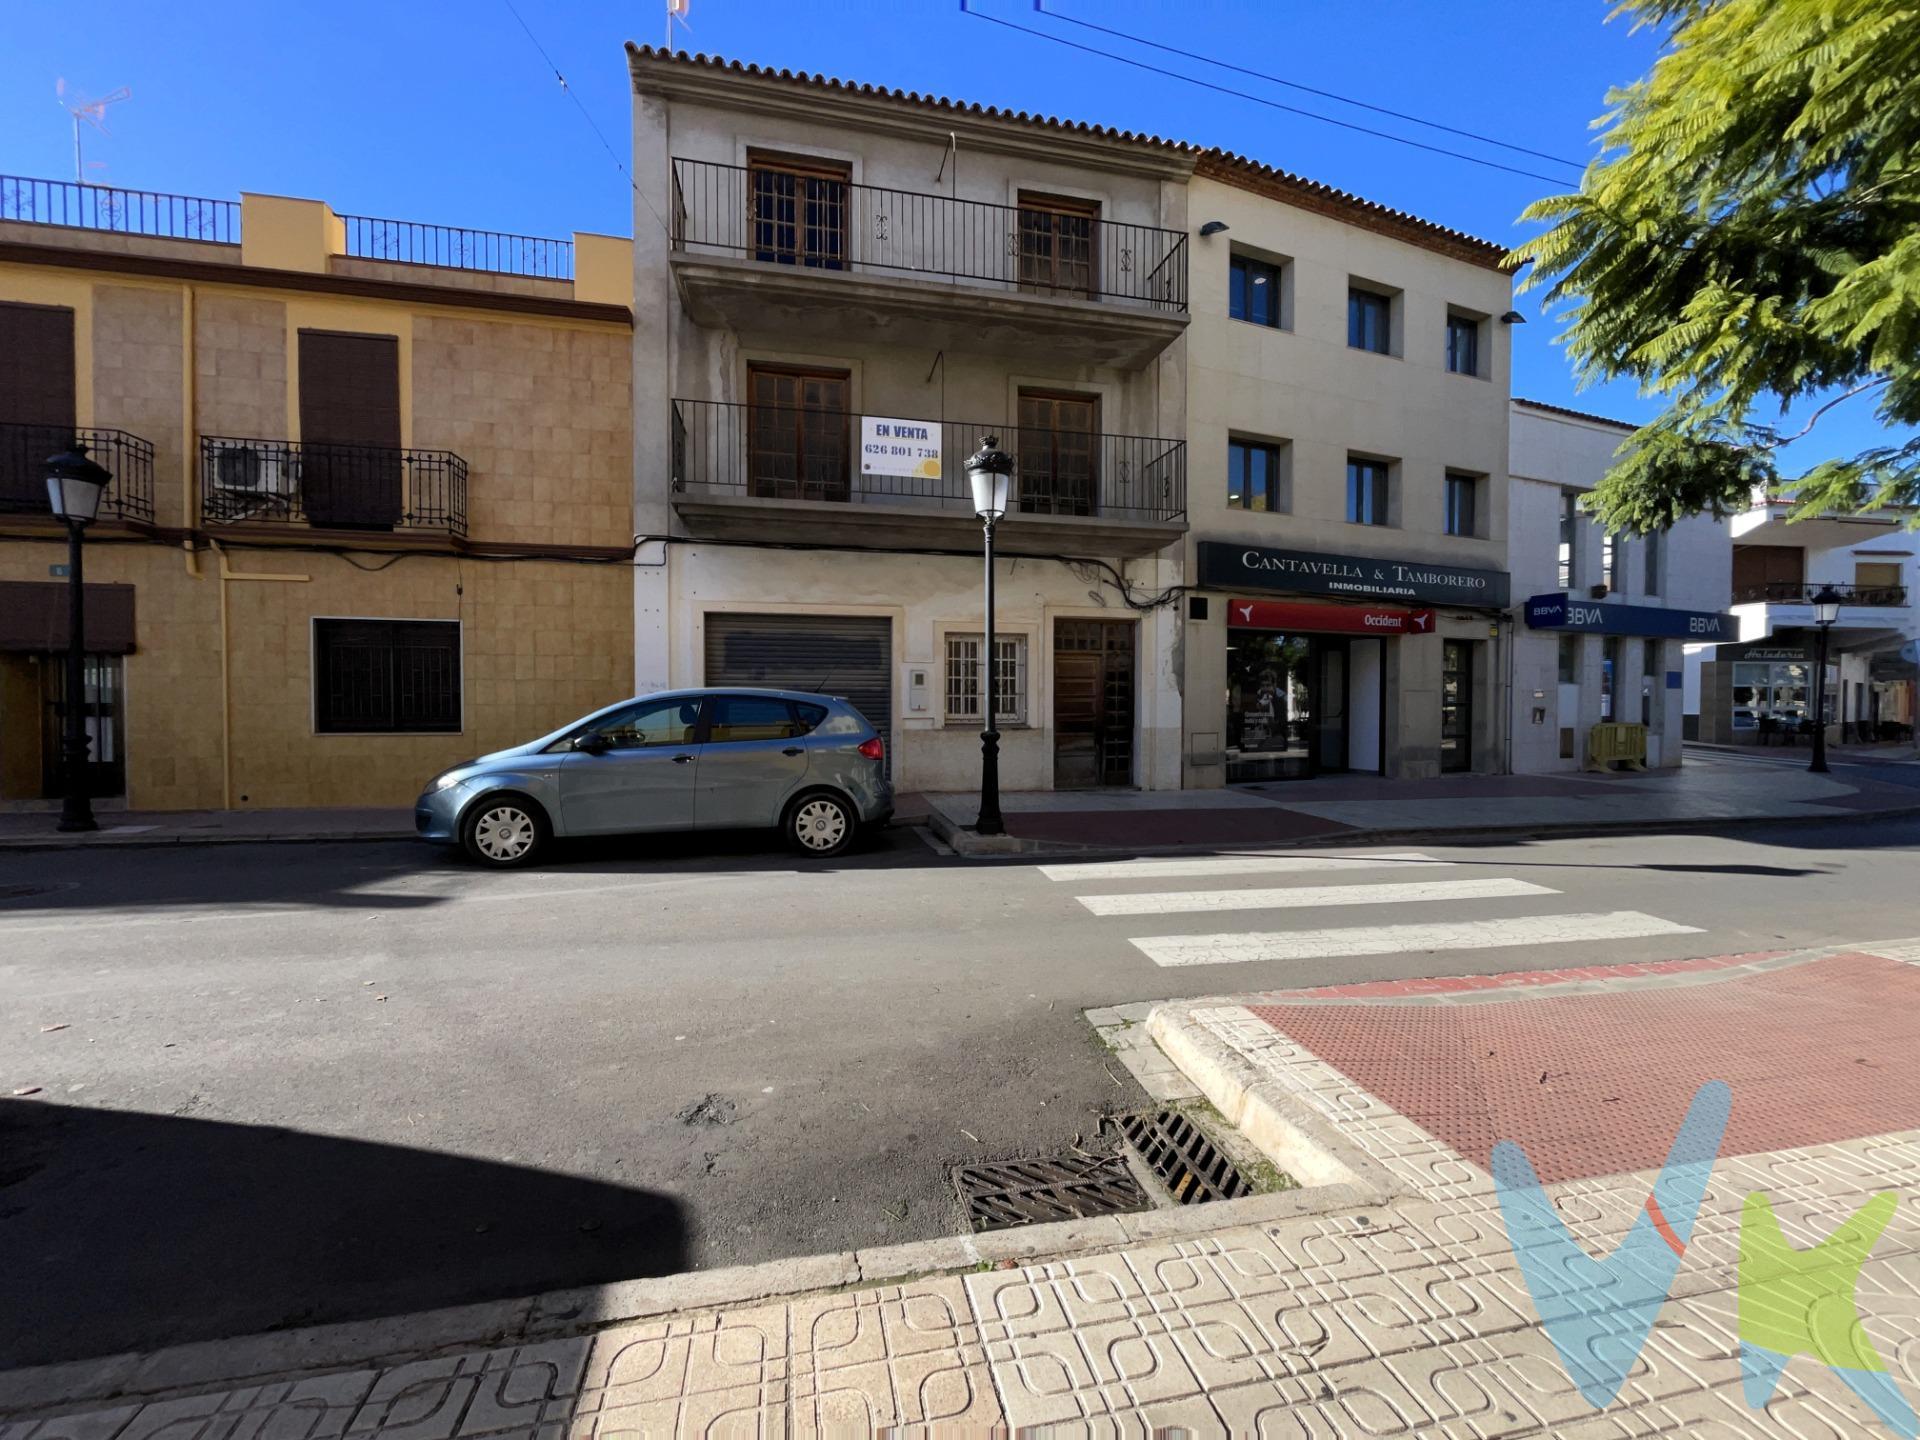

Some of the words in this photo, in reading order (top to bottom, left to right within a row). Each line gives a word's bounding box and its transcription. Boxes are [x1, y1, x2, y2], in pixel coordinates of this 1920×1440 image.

[876, 424, 889, 436] EN
[894, 426, 928, 440] VENTA
[865, 444, 888, 454] 626
[891, 446, 911, 456] 801
[917, 448, 938, 458] 738
[1374, 568, 1384, 580] &
[1329, 582, 1416, 596] INMOBILIARIA
[1533, 605, 1562, 616] BBVA
[1364, 614, 1402, 628] Occident
[1689, 617, 1720, 633] BBVA
